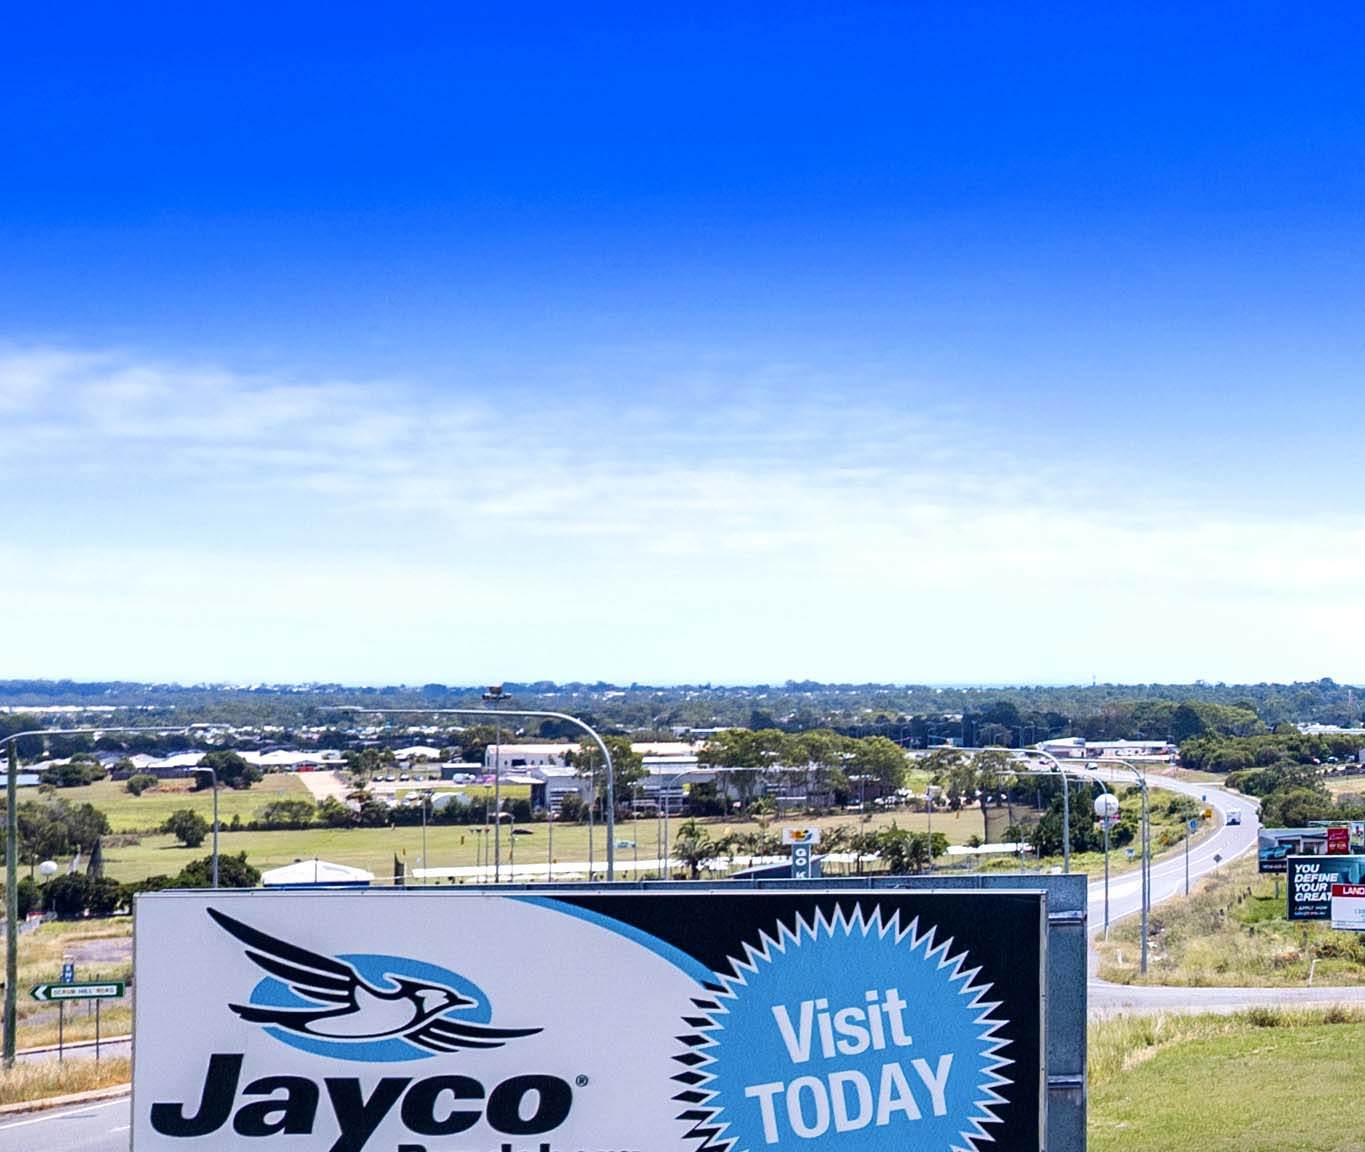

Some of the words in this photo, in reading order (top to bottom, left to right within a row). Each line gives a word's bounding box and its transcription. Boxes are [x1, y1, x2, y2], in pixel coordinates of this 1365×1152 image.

[1295, 864, 1320, 873] YOU
[1295, 873, 1338, 882] DEFINE
[1295, 883, 1328, 892] YOUR
[1343, 887, 1365, 895] LAND
[771, 988, 914, 1064] Visit
[744, 1053, 954, 1144] TODAY
